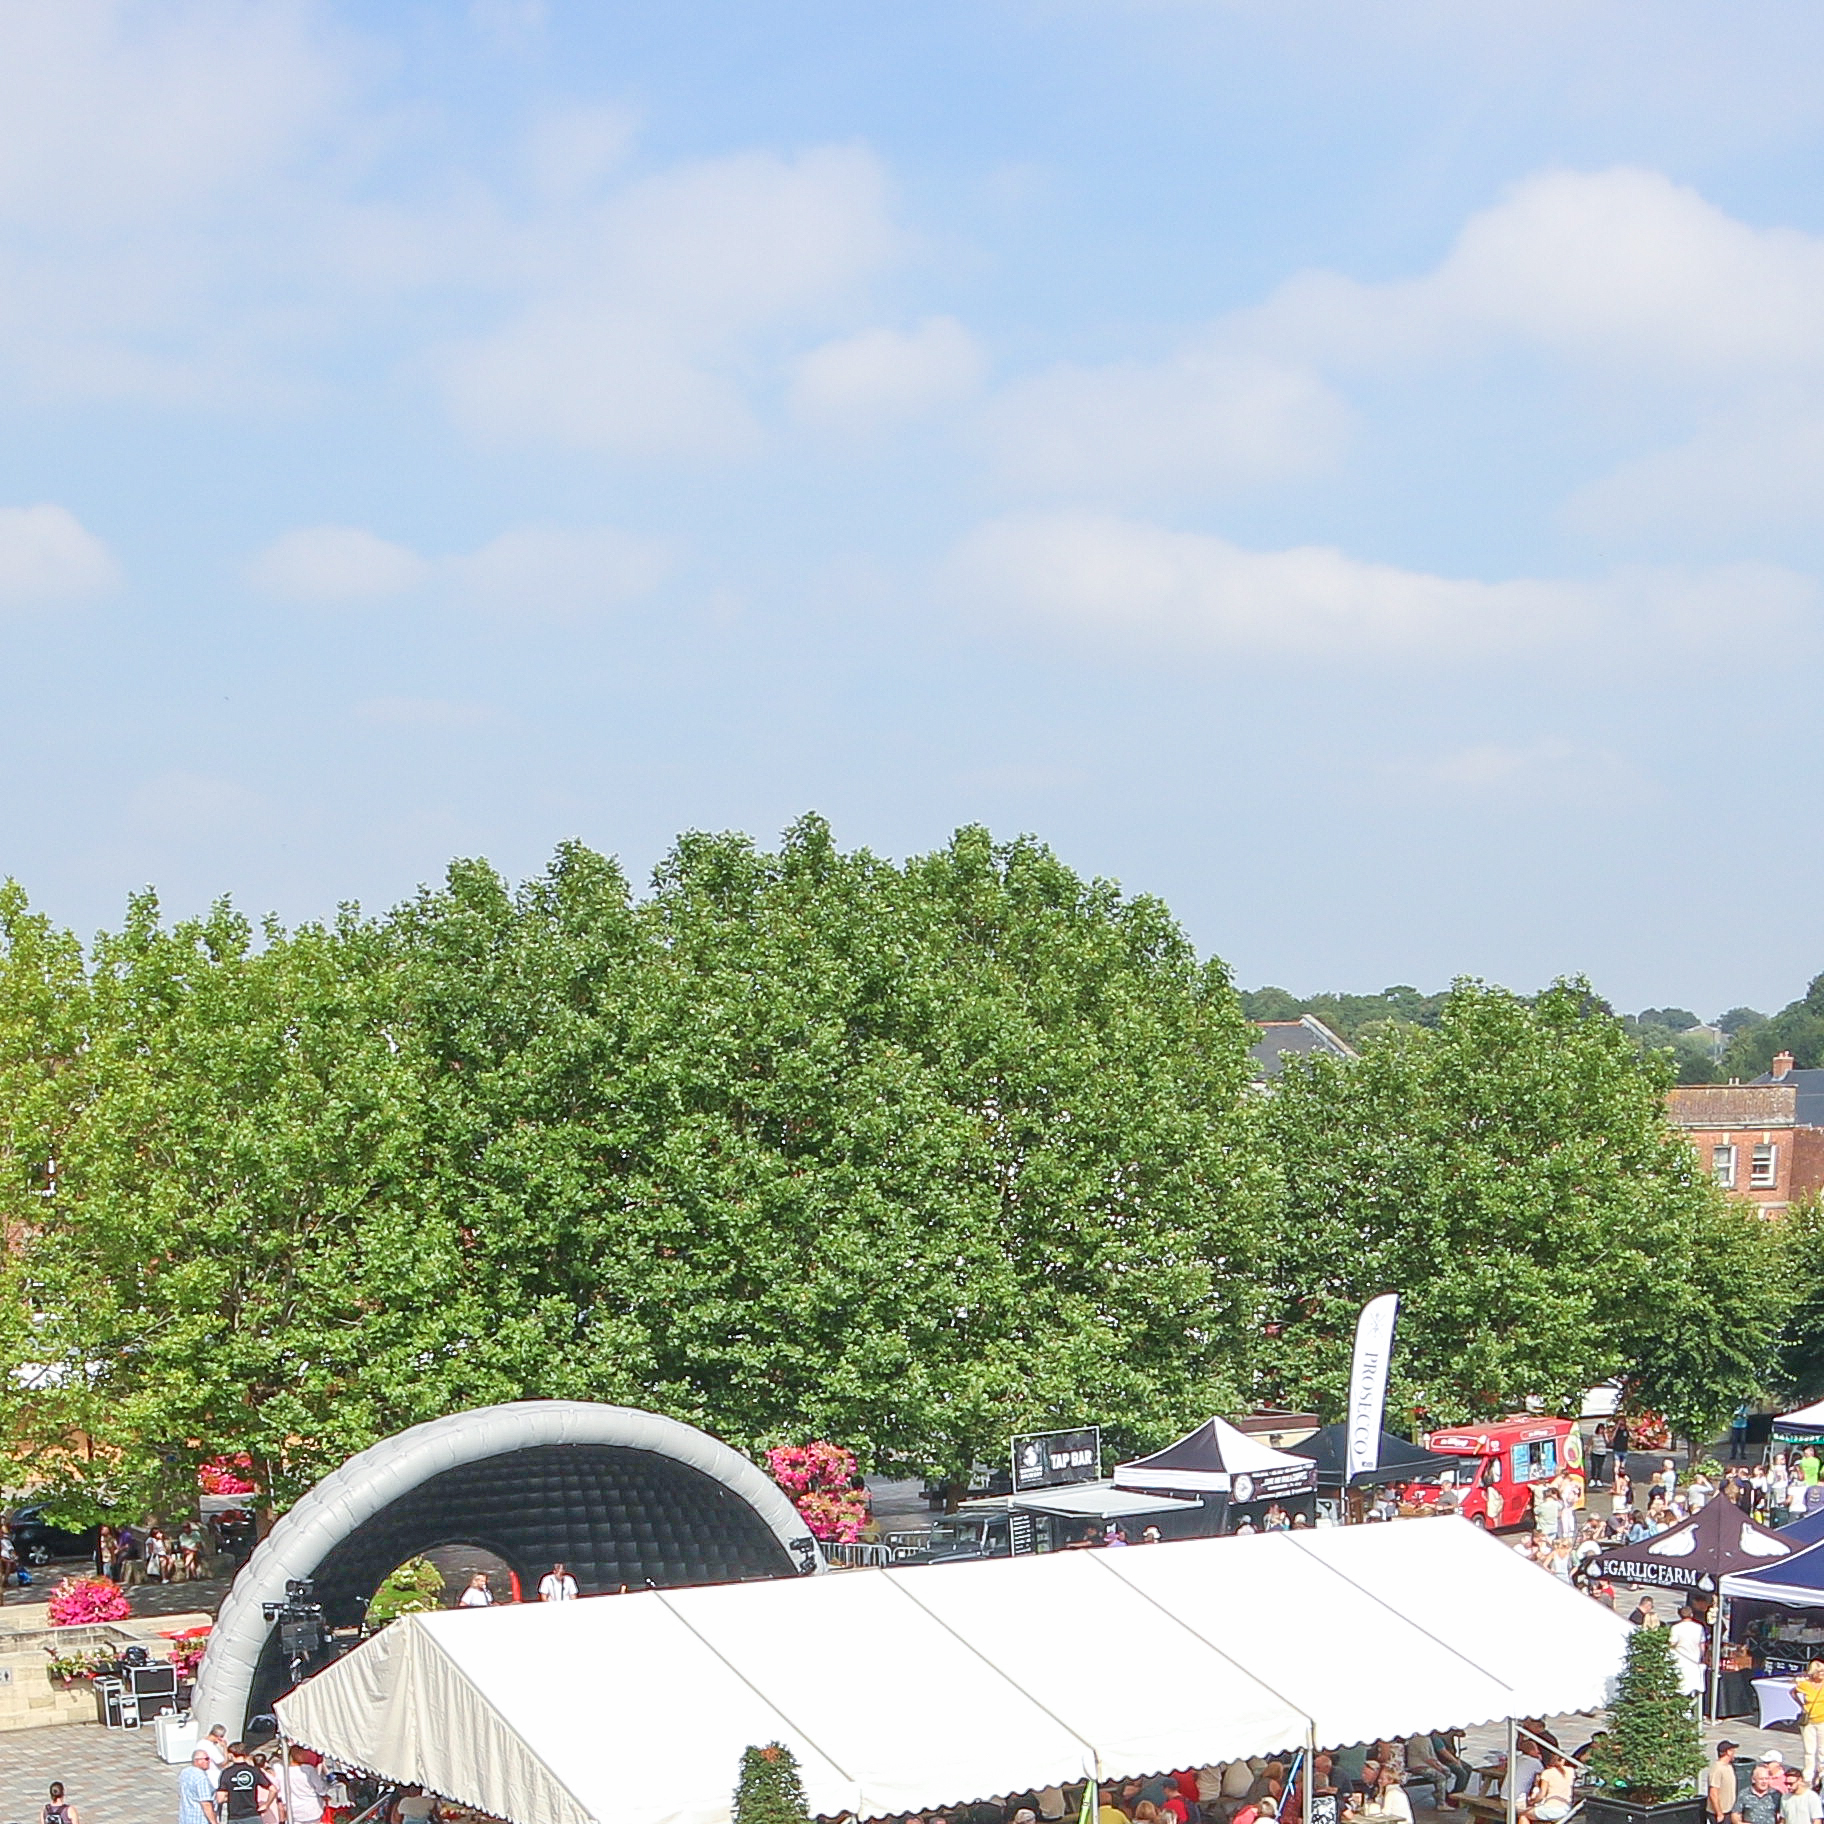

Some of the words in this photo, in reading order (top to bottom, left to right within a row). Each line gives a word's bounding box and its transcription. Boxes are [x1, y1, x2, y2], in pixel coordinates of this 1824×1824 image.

[1353, 1352, 1379, 1455] PROSECCO
[1050, 1452, 1070, 1470] TAP
[1071, 1449, 1093, 1467] BAR
[1608, 1560, 1658, 1579] GARLIC
[1658, 1565, 1697, 1586] FARM
